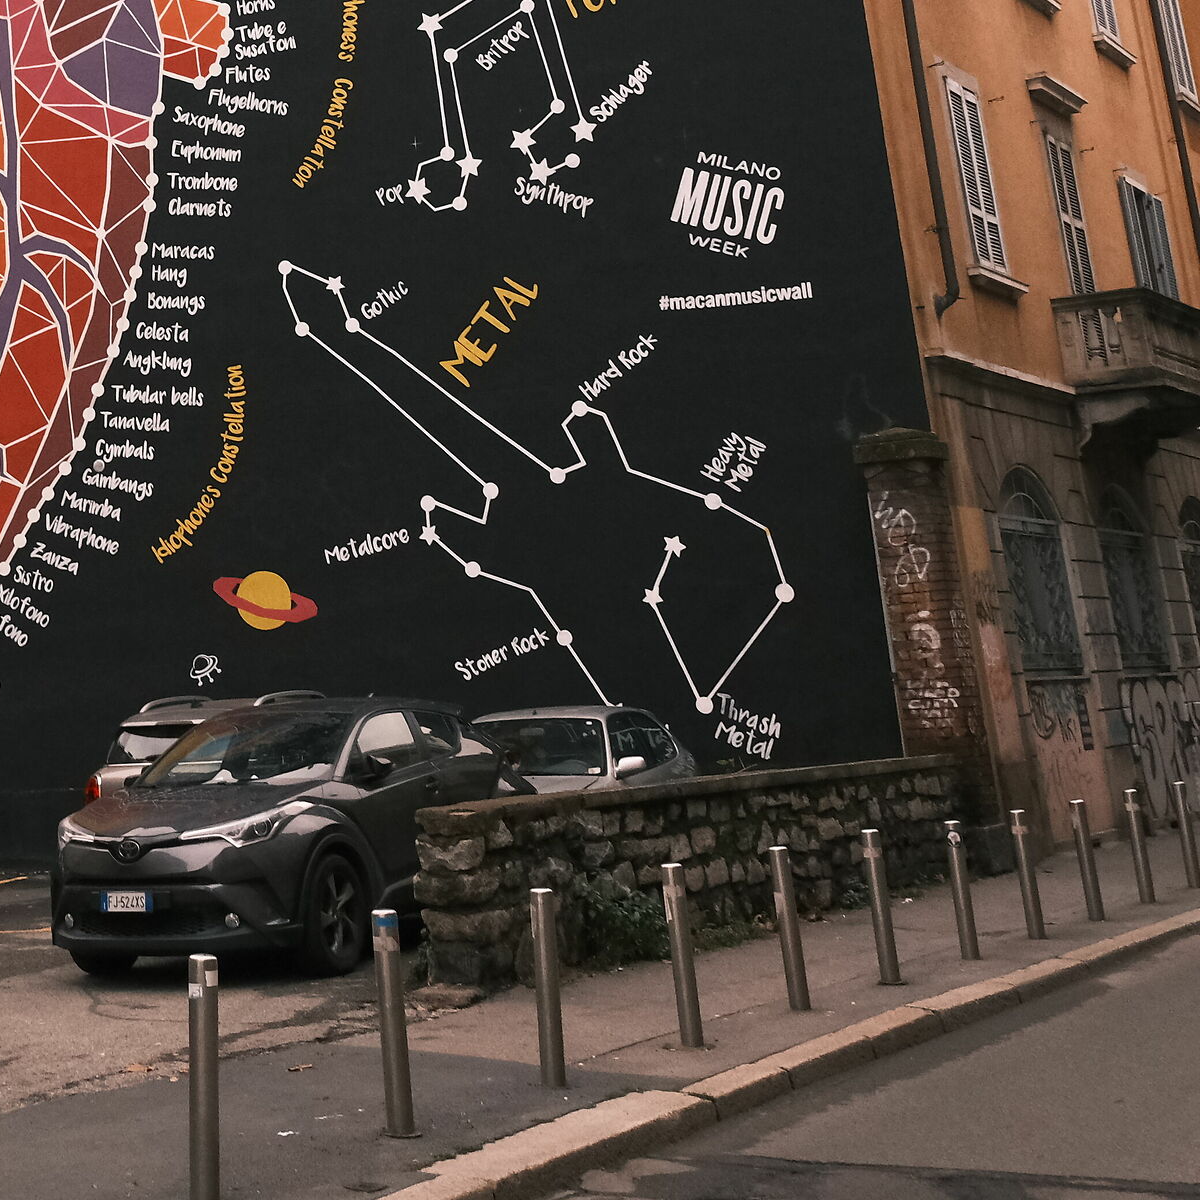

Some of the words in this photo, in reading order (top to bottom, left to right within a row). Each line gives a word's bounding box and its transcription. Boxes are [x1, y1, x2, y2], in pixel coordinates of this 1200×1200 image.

[225, 63, 271, 85] Flutes
[589, 60, 652, 122] Schlager
[207, 88, 289, 116] Flugelhorns
[172, 106, 245, 137] Saxophone
[291, 77, 354, 189] Constellation
[167, 172, 237, 191] Trombone
[697, 151, 781, 181] MILANO
[670, 167, 785, 245] MUSIC
[151, 242, 216, 260] Maracas
[688, 233, 750, 258] WEEK
[151, 264, 188, 288] Hang
[147, 291, 206, 316] Bonangs
[361, 280, 410, 320] Gothic
[659, 281, 813, 311] #macanmusicwall
[135, 321, 189, 343] Celesta
[438, 276, 539, 388] METAL
[578, 359, 623, 401] Hard
[617, 333, 658, 370] Rock
[111, 384, 166, 404] Tubular
[171, 386, 204, 407] bells
[210, 364, 246, 484] Constellation
[95, 439, 155, 463] Cymbals
[700, 432, 747, 482] Heavy
[724, 436, 767, 493] Metal
[45, 513, 120, 555] Vibraphone
[324, 527, 410, 565] Metalcore
[454, 645, 508, 681] Stoner
[510, 627, 550, 656] Rock
[716, 692, 782, 739] Thrash
[714, 721, 775, 761] Metal
